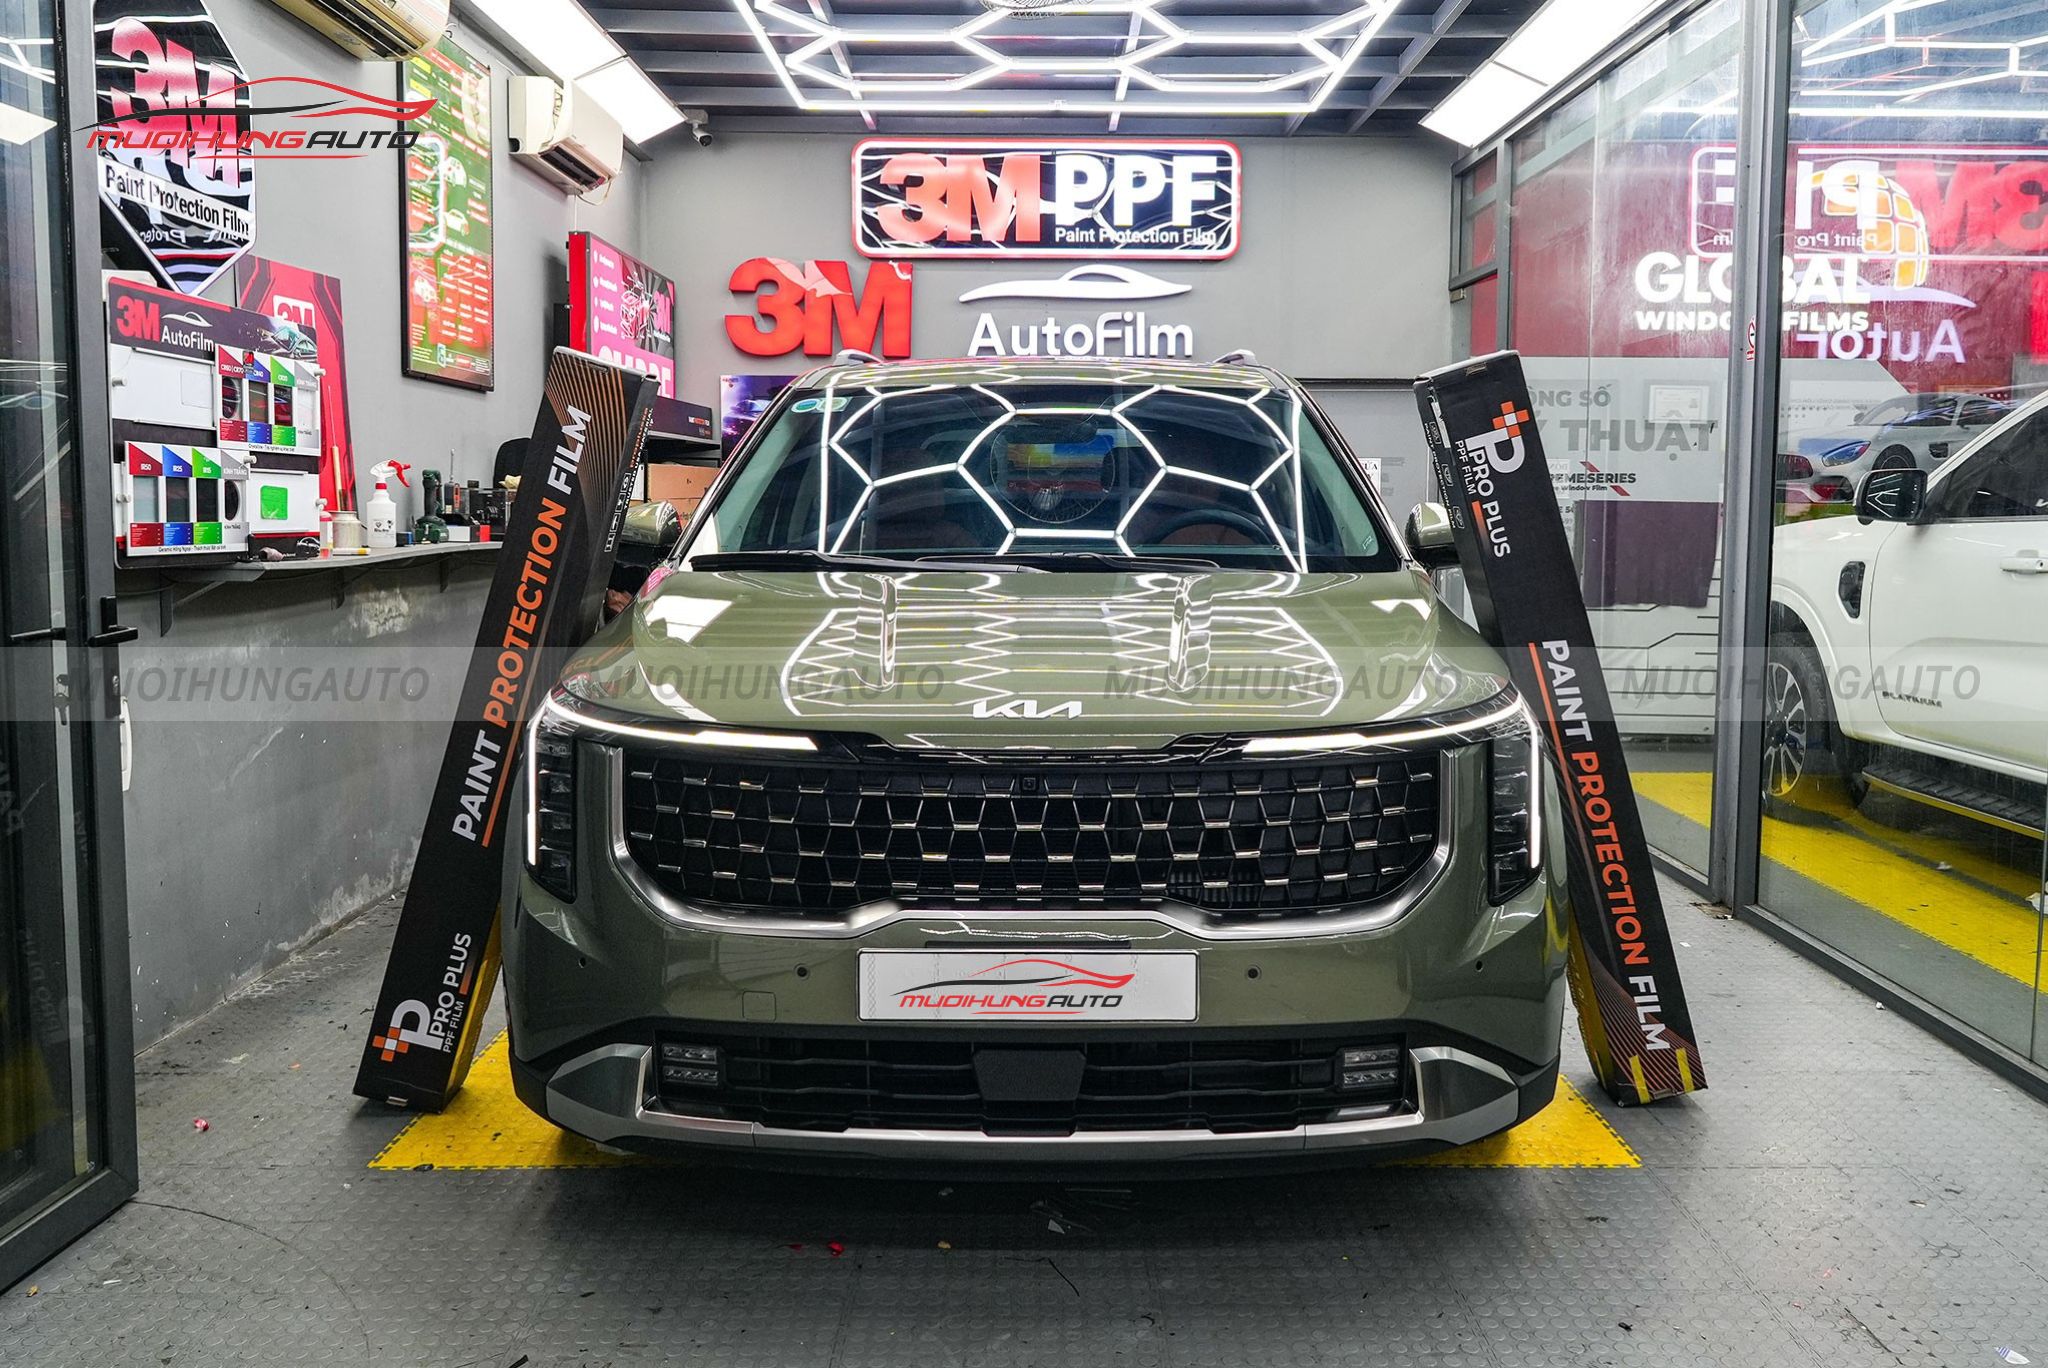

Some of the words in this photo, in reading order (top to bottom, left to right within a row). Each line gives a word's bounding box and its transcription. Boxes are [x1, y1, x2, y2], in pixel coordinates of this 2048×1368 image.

[111, 18, 239, 188] 3M
[105, 164, 145, 200] Paint
[150, 180, 219, 227] Protection
[222, 206, 249, 236] Film
[877, 152, 1041, 242] 3M
[1055, 154, 1221, 227] PPF
[1055, 227, 1095, 243] Paint
[1100, 227, 1180, 244] Protection
[1183, 228, 1217, 244] Film
[116, 294, 161, 342] 3M
[724, 256, 914, 357] 3M
[161, 324, 215, 353] AutoFilm
[967, 311, 1194, 357] AutoFilm
[1455, 439, 1471, 468] PPF
[1462, 466, 1478, 495] FILM
[1468, 448, 1495, 498] PRO
[1482, 500, 1511, 558] PLUS
[452, 729, 502, 842] PAINT
[483, 497, 568, 729] PROTECTION
[547, 404, 592, 496] FILM
[1541, 639, 1593, 742] PAINT
[1571, 751, 1650, 966] PROTECTION
[1628, 975, 1671, 1051] FILM
[442, 932, 472, 988] PLUS
[429, 991, 456, 1037] PRO
[443, 1026, 458, 1053] PPF
[449, 1000, 465, 1028] FILM
